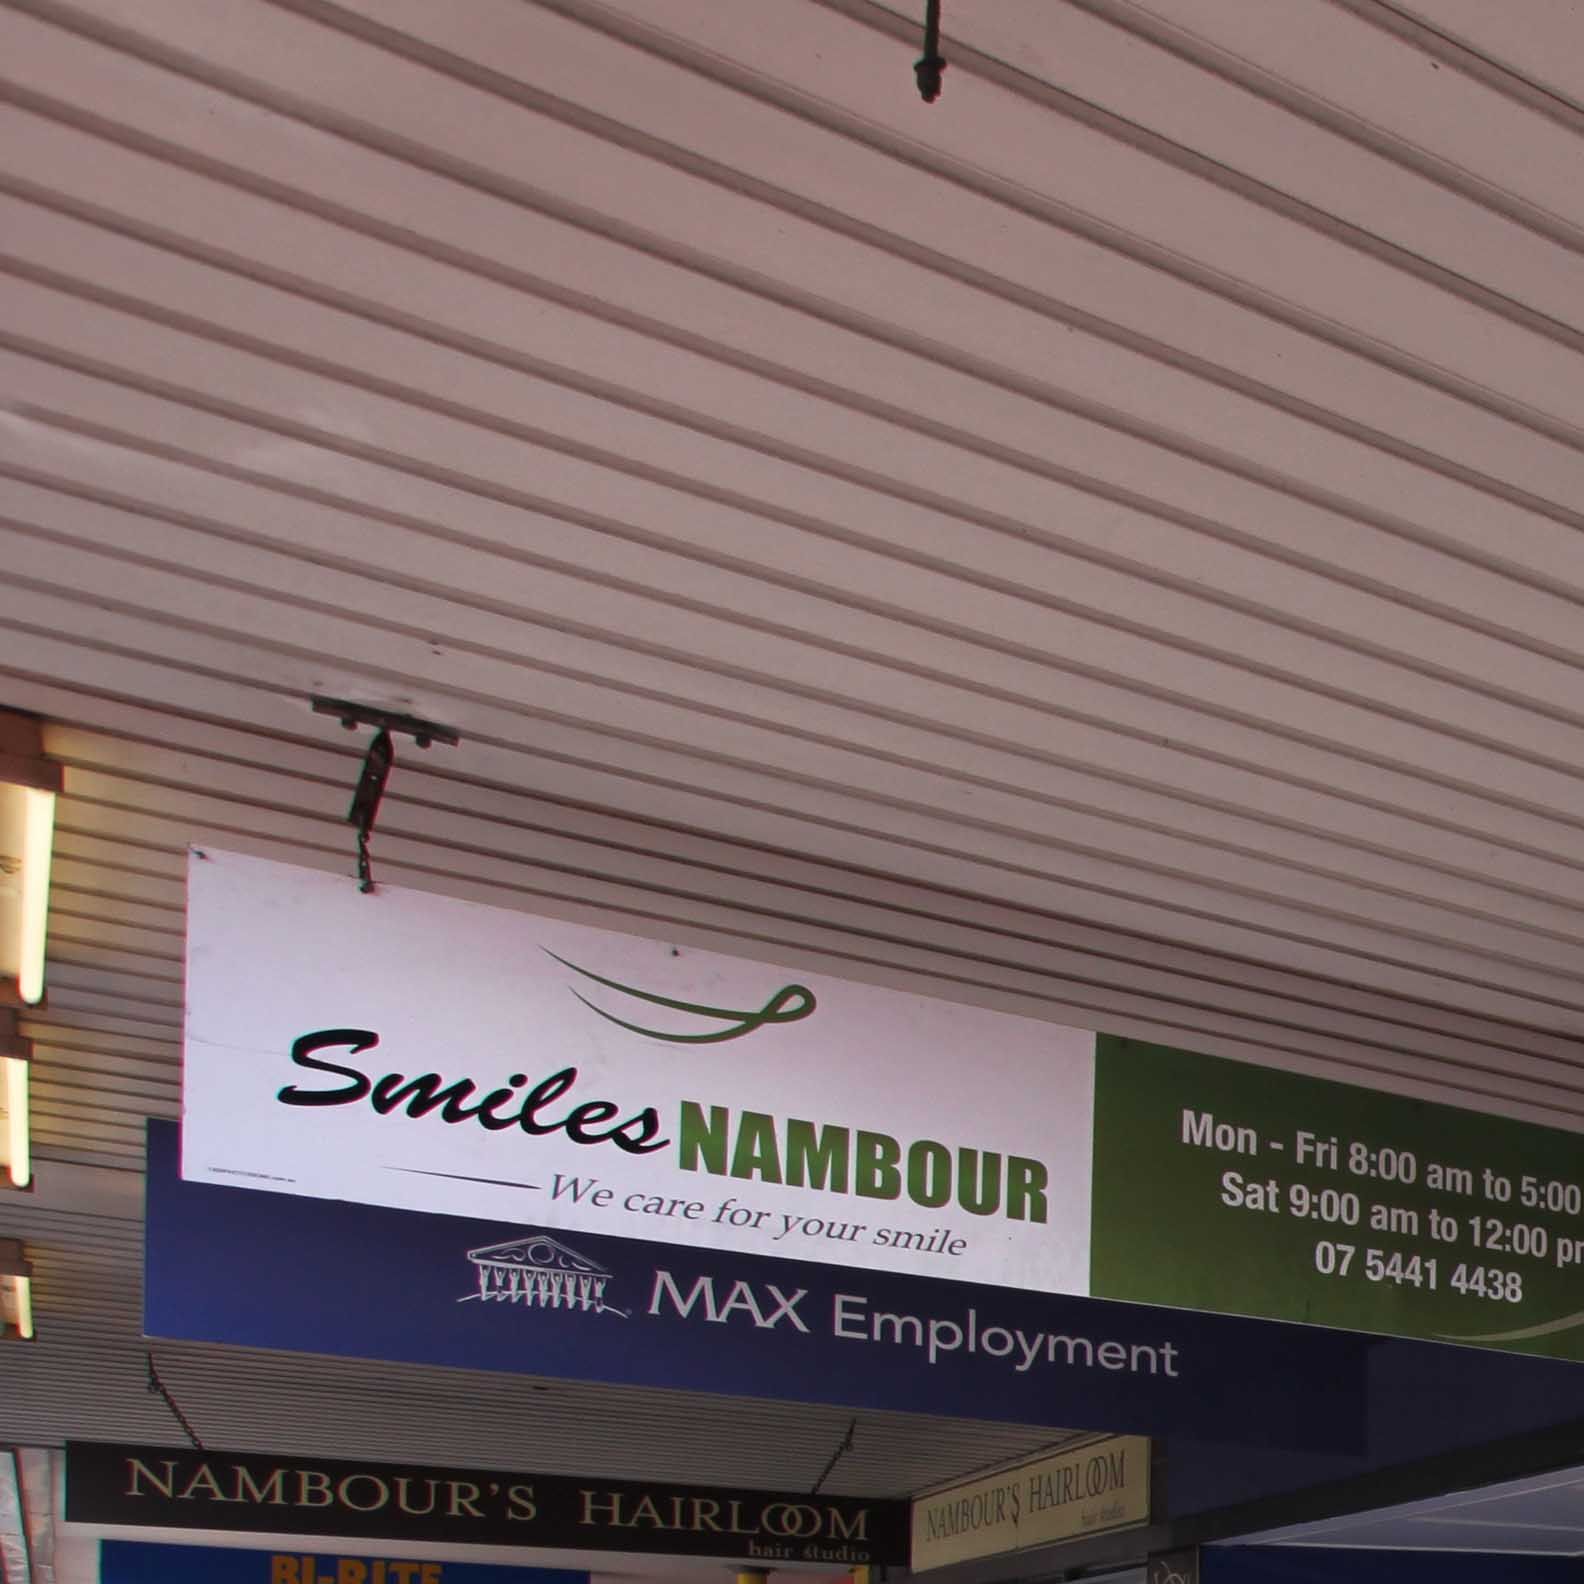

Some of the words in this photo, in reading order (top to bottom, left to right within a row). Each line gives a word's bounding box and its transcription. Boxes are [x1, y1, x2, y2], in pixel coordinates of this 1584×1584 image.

[276, 1027, 670, 1155] Smiles
[678, 1100, 1049, 1224] NAMBOUR
[1181, 1109, 1258, 1157] Mon
[1296, 1131, 1338, 1170] Fri
[1348, 1142, 1417, 1185] 8:00
[1427, 1163, 1474, 1193] am
[1483, 1162, 1512, 1202] to
[1521, 1170, 1583, 1216] 5:00
[551, 1173, 616, 1208] We
[622, 1189, 709, 1218] care
[720, 1196, 772, 1233] for
[780, 1211, 863, 1248] your
[873, 1215, 968, 1257] smile
[1221, 1171, 1280, 1215] Sat
[1289, 1185, 1361, 1226] 9:00
[1370, 1204, 1419, 1235] am
[1429, 1204, 1460, 1243] to
[1469, 1215, 1547, 1260] 12:00
[1315, 1241, 1356, 1278] 07
[1365, 1249, 1439, 1292] 5441
[1450, 1261, 1524, 1304] 4438
[648, 1269, 810, 1334] MAX
[834, 1295, 1180, 1378] Employment
[124, 1457, 537, 1521] NAMBOUR'S
[580, 1490, 870, 1542] HAIRLOOM
[926, 1482, 1020, 1542] NAMBOUR'S
[1029, 1449, 1126, 1513] HAIRLOOM
[748, 1542, 792, 1558] hair
[803, 1543, 870, 1562] studio
